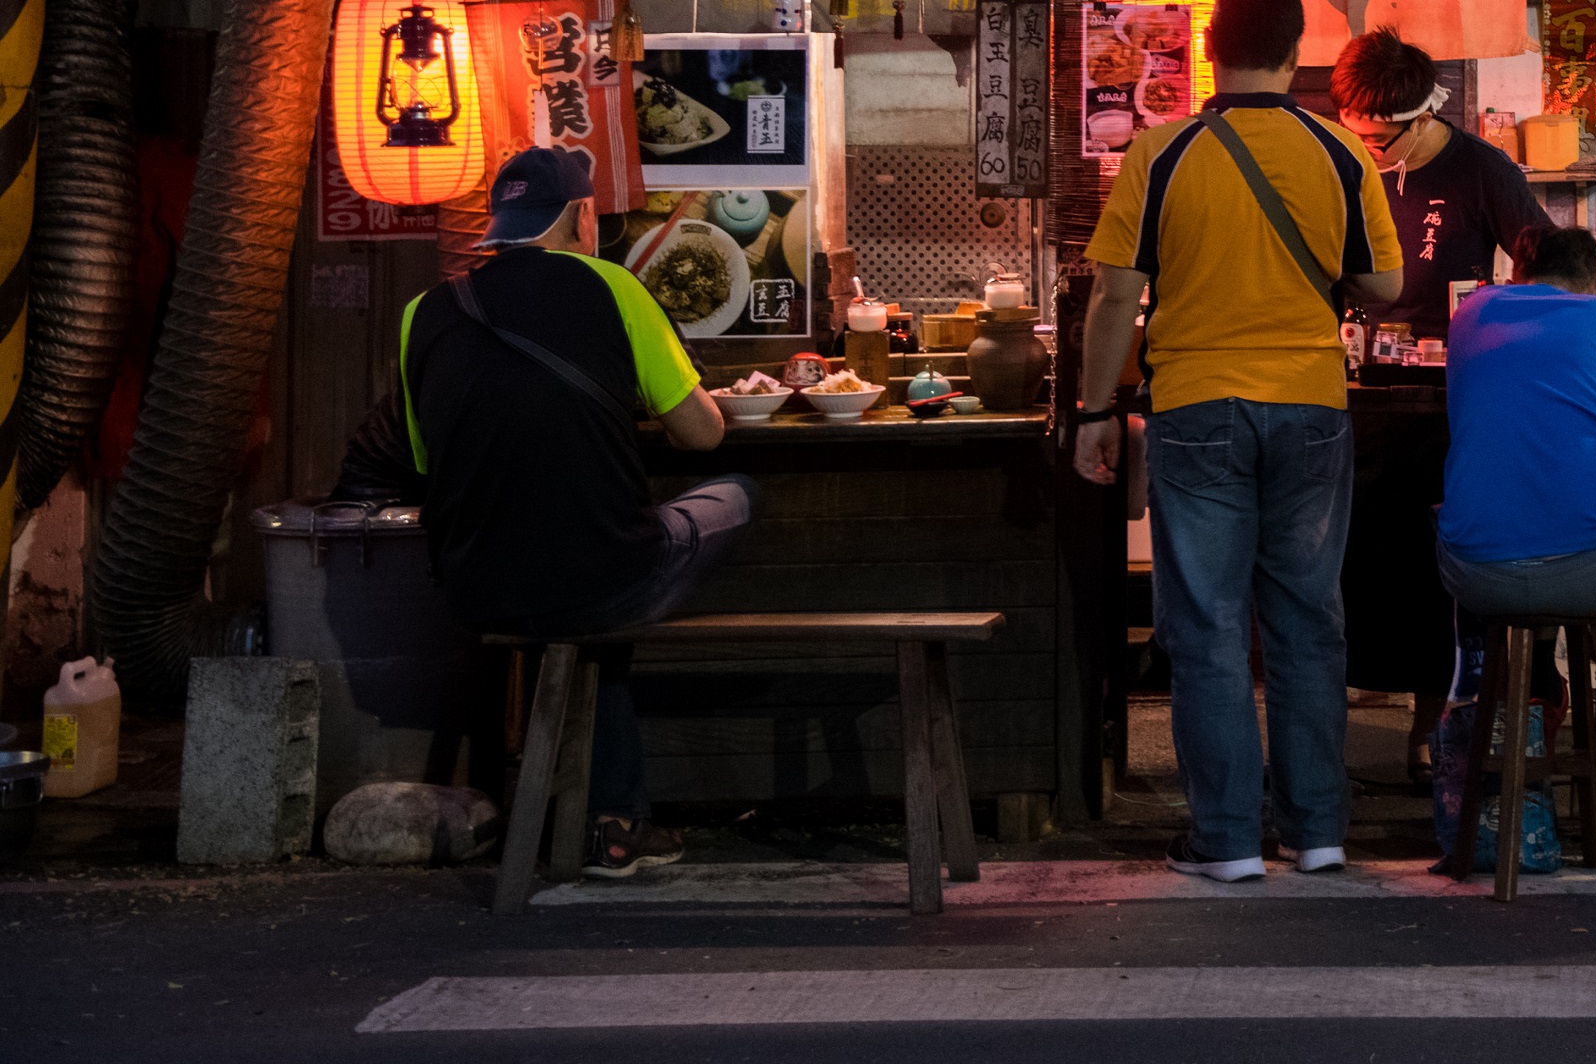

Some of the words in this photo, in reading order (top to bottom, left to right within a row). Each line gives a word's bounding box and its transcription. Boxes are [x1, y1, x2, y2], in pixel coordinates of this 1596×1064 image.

[980, 152, 1005, 176] 60
[1017, 155, 1042, 181] 50
[1419, 199, 1446, 261] 一碗豆腐
